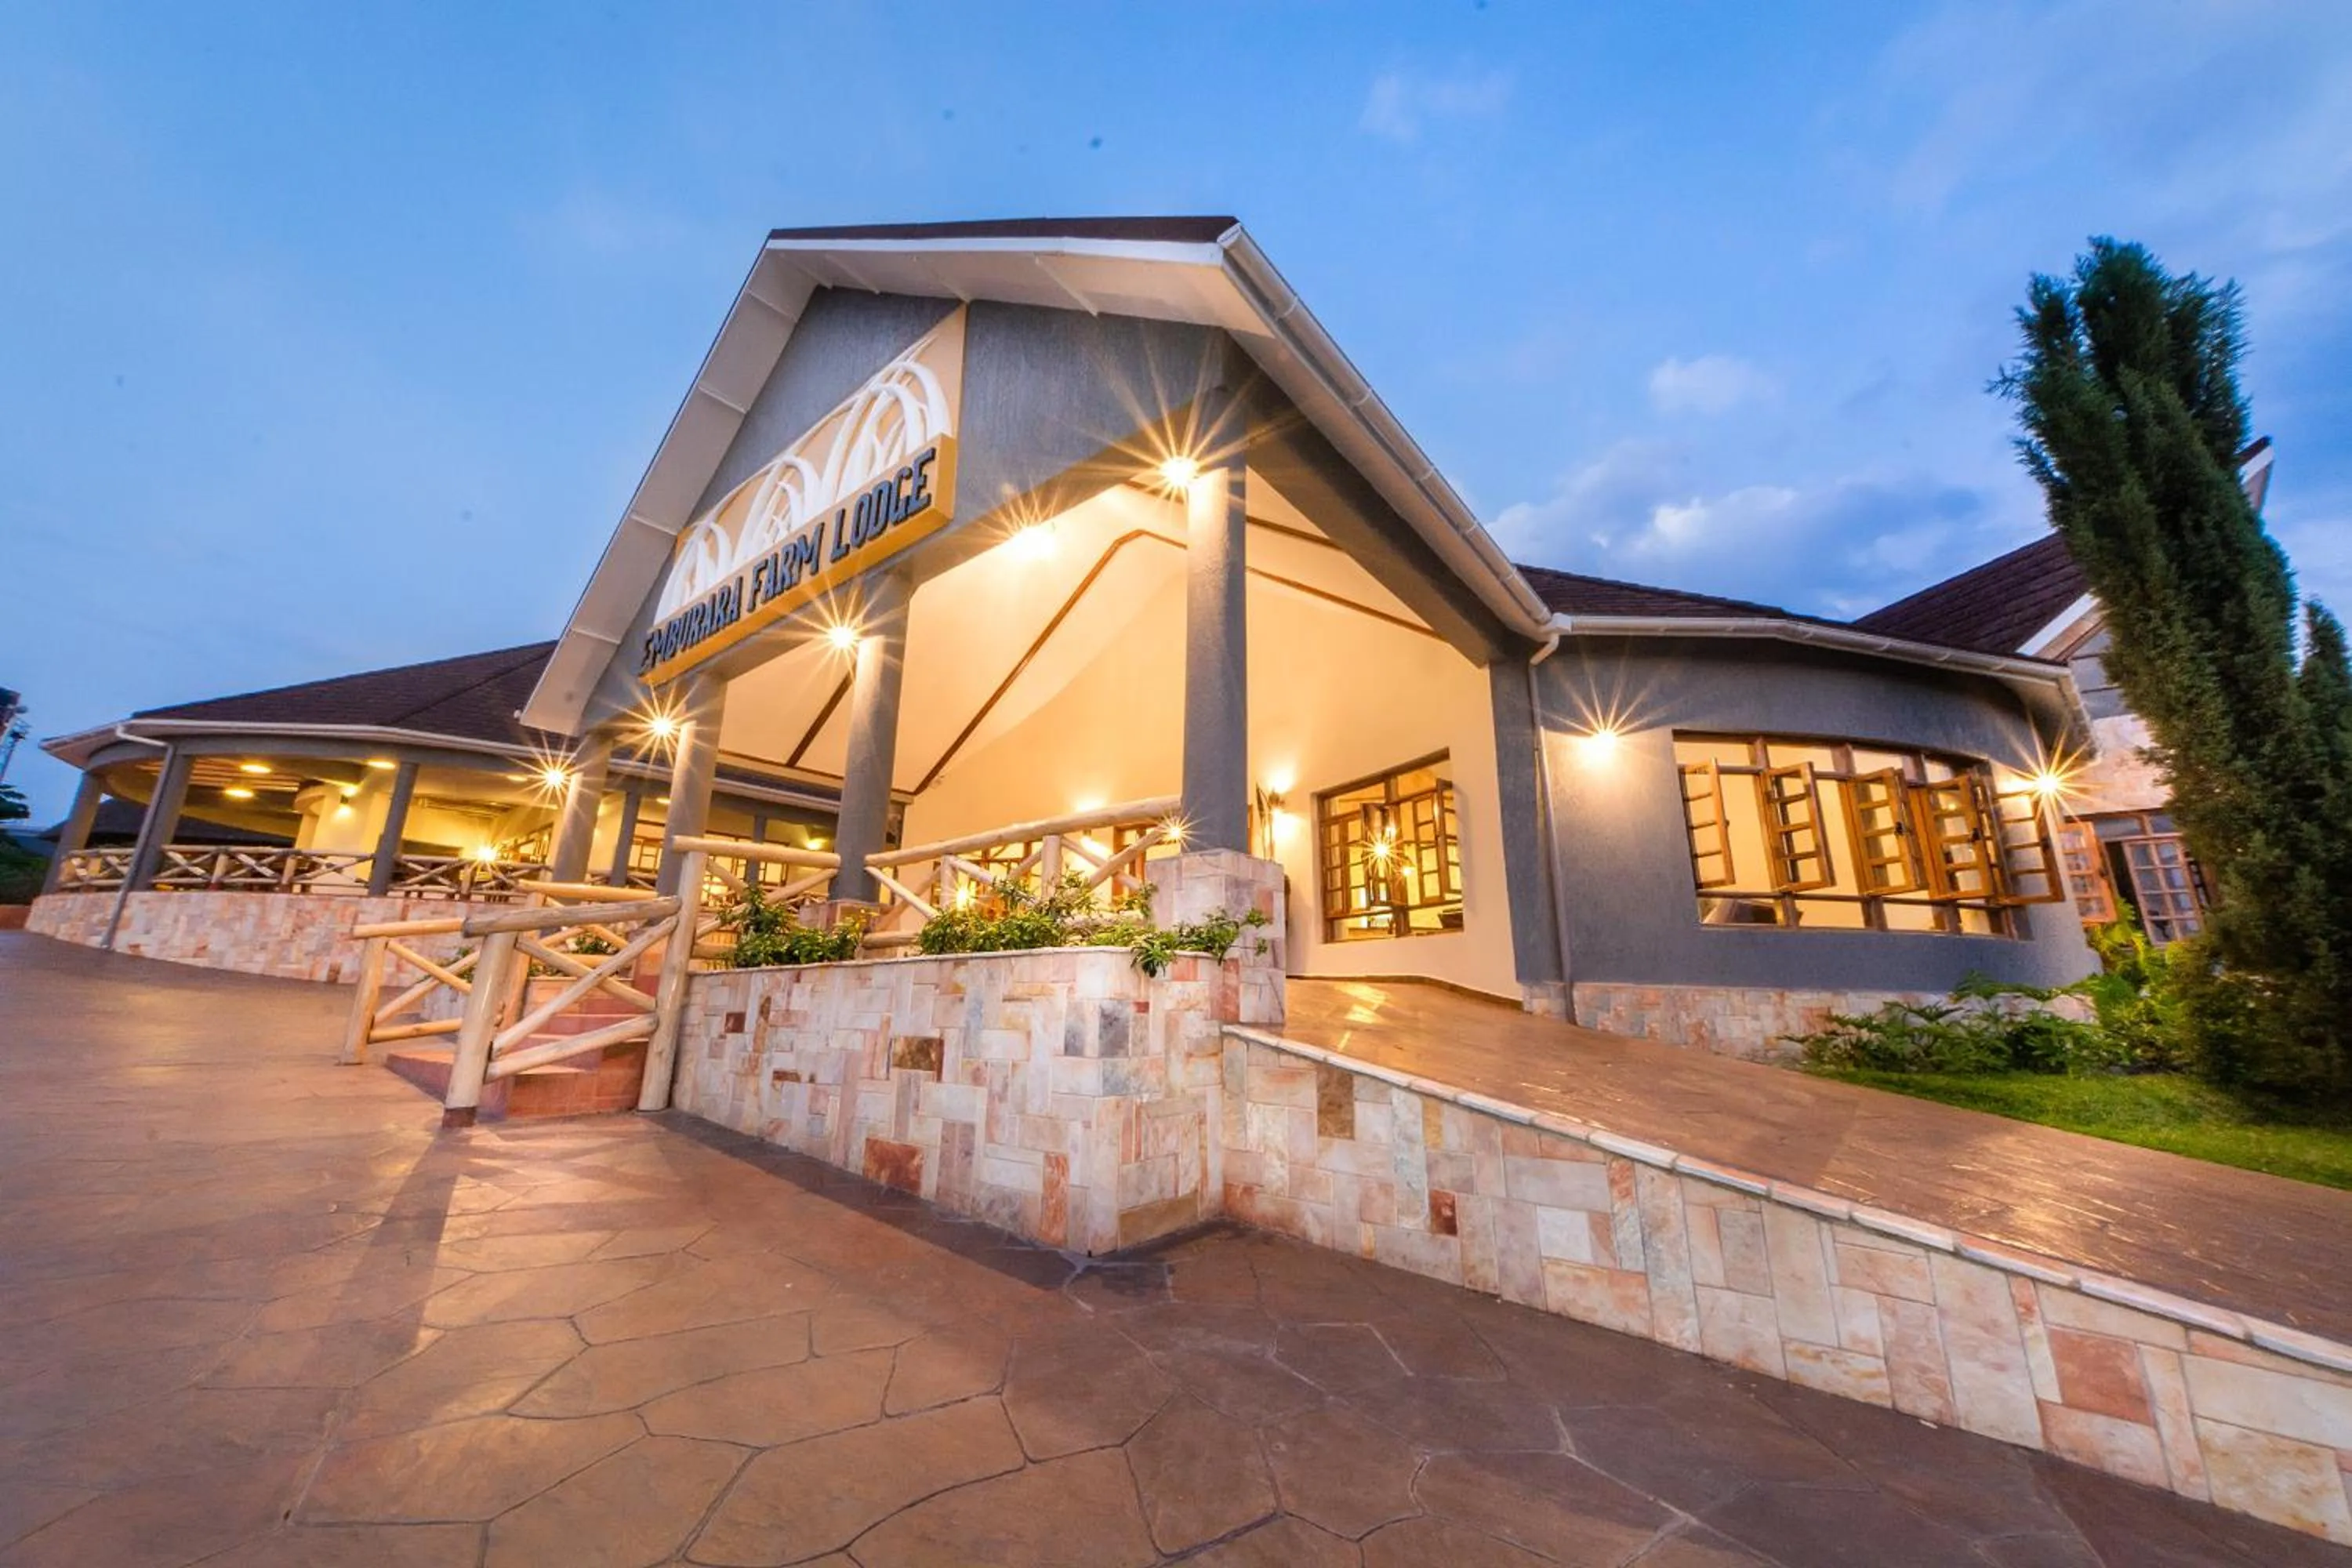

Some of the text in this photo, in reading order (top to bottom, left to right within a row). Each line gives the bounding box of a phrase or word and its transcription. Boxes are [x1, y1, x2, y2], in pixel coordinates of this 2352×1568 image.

[640, 448, 936, 670] EMBURARA FARM LODGE
